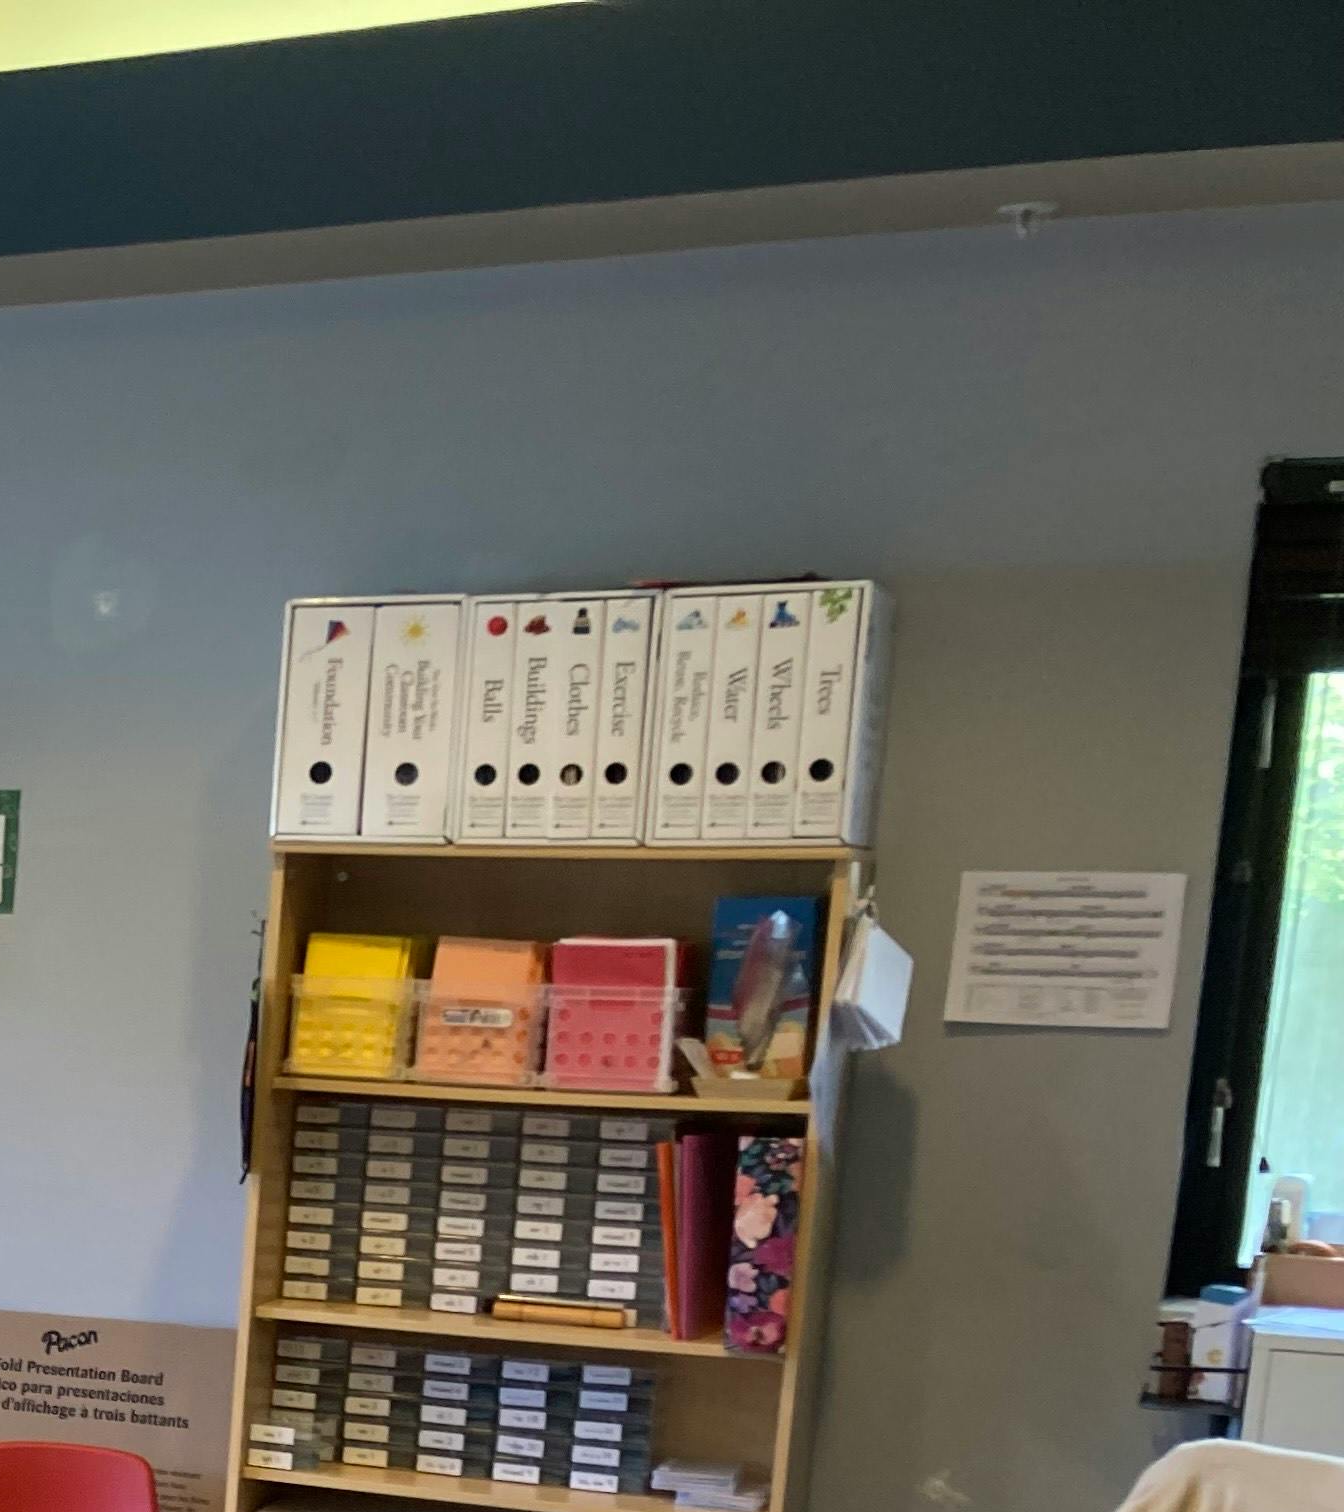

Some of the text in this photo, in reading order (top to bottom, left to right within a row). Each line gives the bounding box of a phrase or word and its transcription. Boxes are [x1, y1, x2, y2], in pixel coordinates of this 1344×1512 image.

[320, 657, 343, 746] Foundation
[412, 660, 431, 711] Building
[481, 679, 504, 723] Balls
[518, 657, 547, 744] Buildings
[566, 663, 591, 736] Clothes
[611, 661, 636, 737] Exercise
[723, 668, 748, 723] Water
[767, 657, 793, 730] Wheels
[818, 664, 842, 715] Trees
[42, 1330, 98, 1354] Pacon
[21, 1383, 53, 1395] para
[56, 1384, 165, 1406] presentaciones
[27, 1361, 116, 1381] Presentation
[121, 1369, 164, 1386] Board
[2, 1396, 76, 1419] d'affichage
[93, 1407, 127, 1422] trois
[130, 1409, 190, 1429] battants
